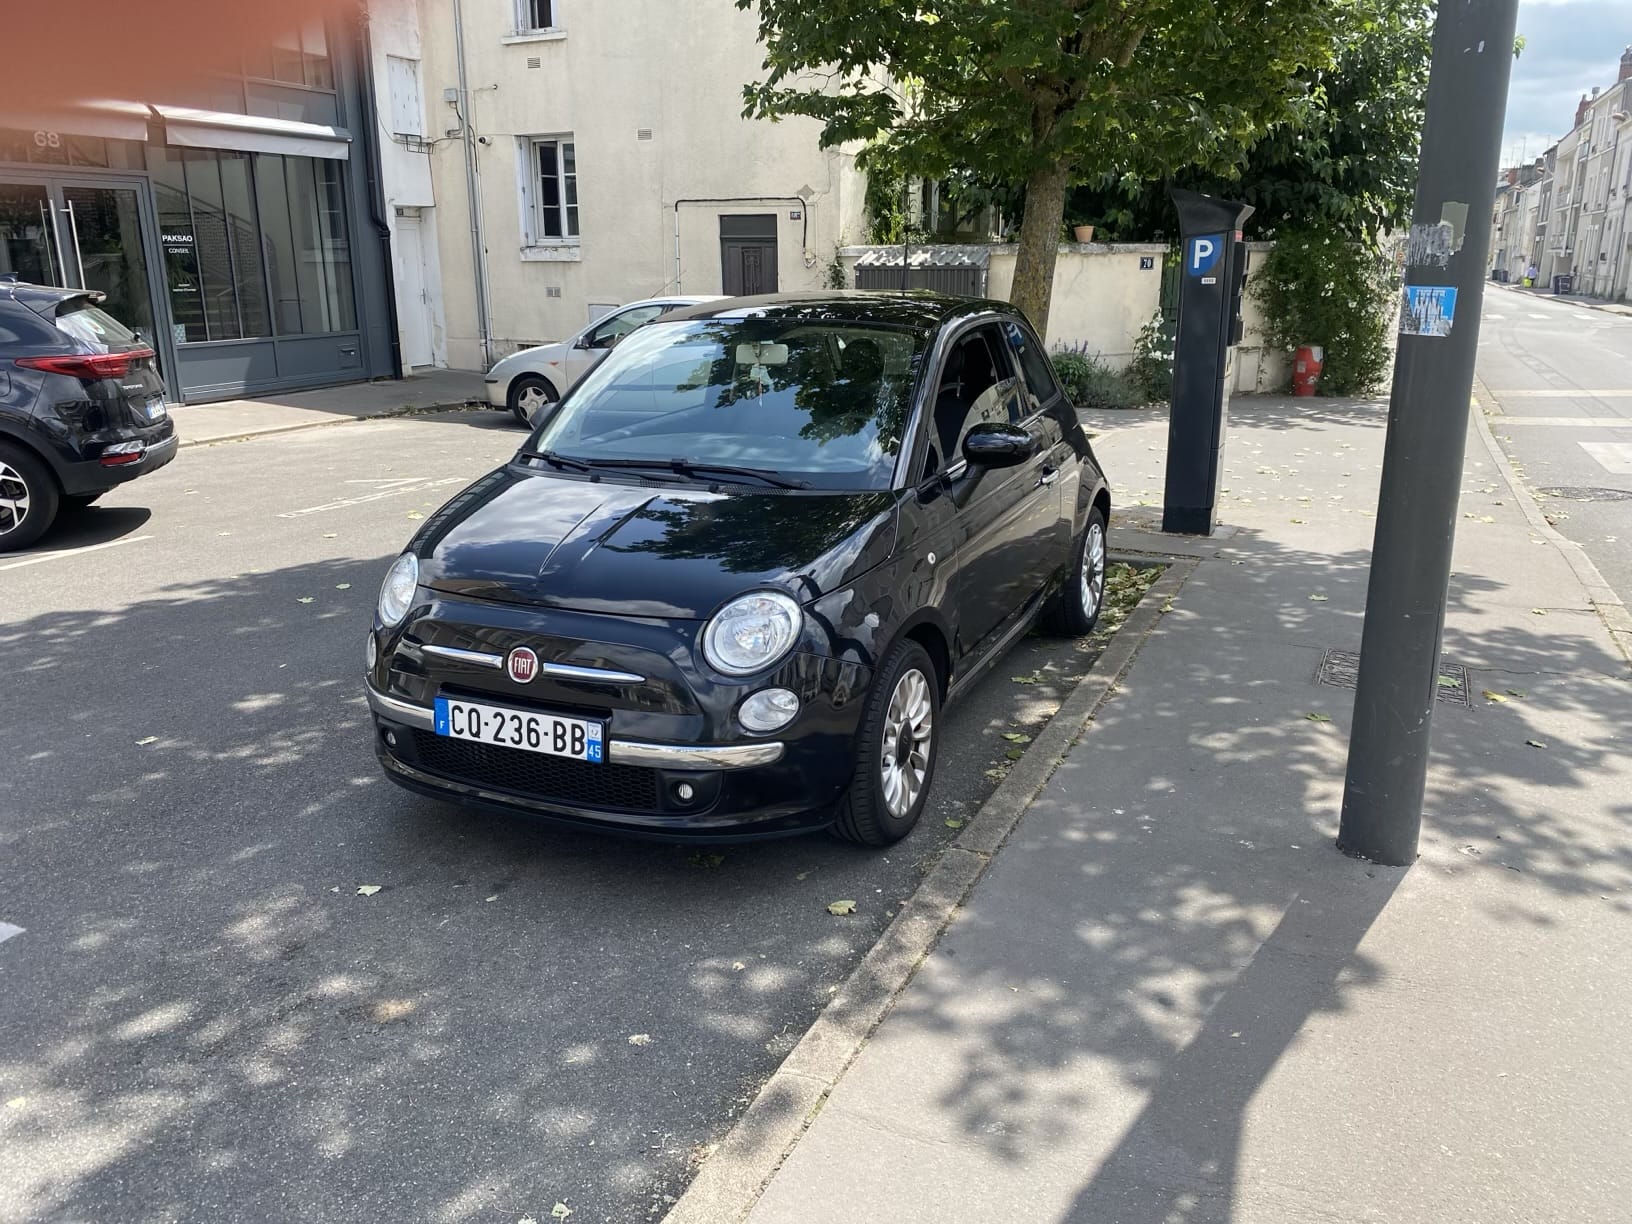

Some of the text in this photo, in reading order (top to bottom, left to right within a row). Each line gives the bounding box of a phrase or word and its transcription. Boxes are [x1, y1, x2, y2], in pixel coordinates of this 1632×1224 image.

[34, 131, 60, 147] 68
[162, 234, 193, 242] PAKSAO
[1193, 239, 1214, 269] P
[1143, 259, 1152, 268] 70
[513, 656, 533, 675] FIAT
[439, 720, 445, 729] F
[451, 704, 586, 756] CQ-236-BB
[588, 744, 601, 759] 45
